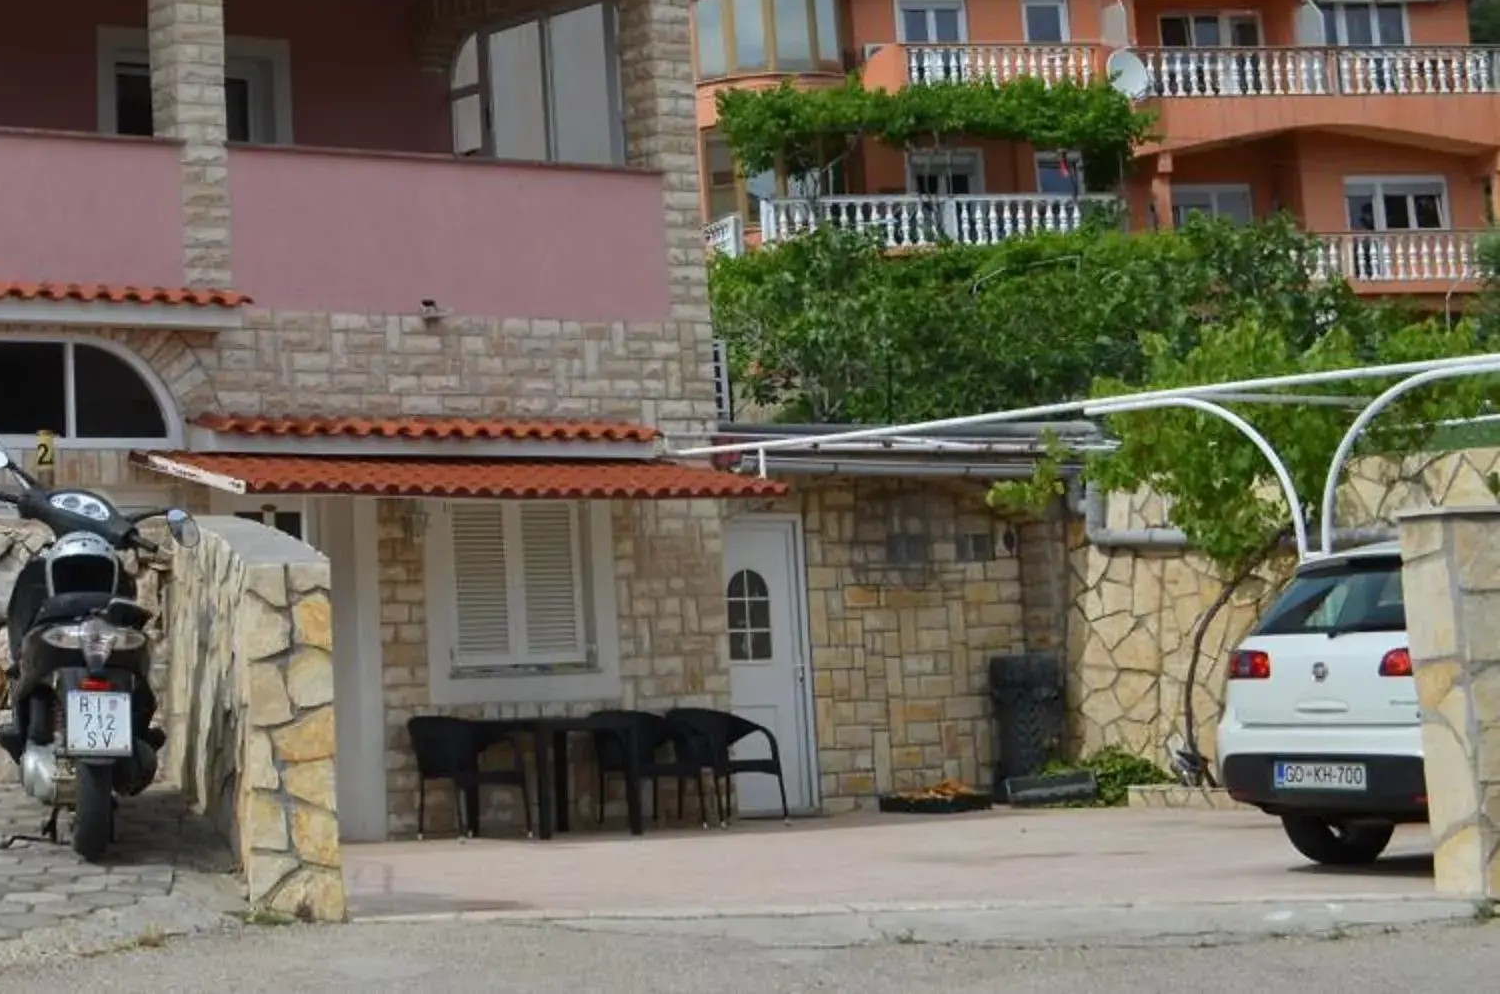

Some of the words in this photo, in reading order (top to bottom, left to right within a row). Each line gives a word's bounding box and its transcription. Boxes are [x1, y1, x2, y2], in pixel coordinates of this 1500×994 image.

[37, 443, 54, 465] 2
[83, 714, 116, 731] 712
[87, 731, 113, 748] SV
